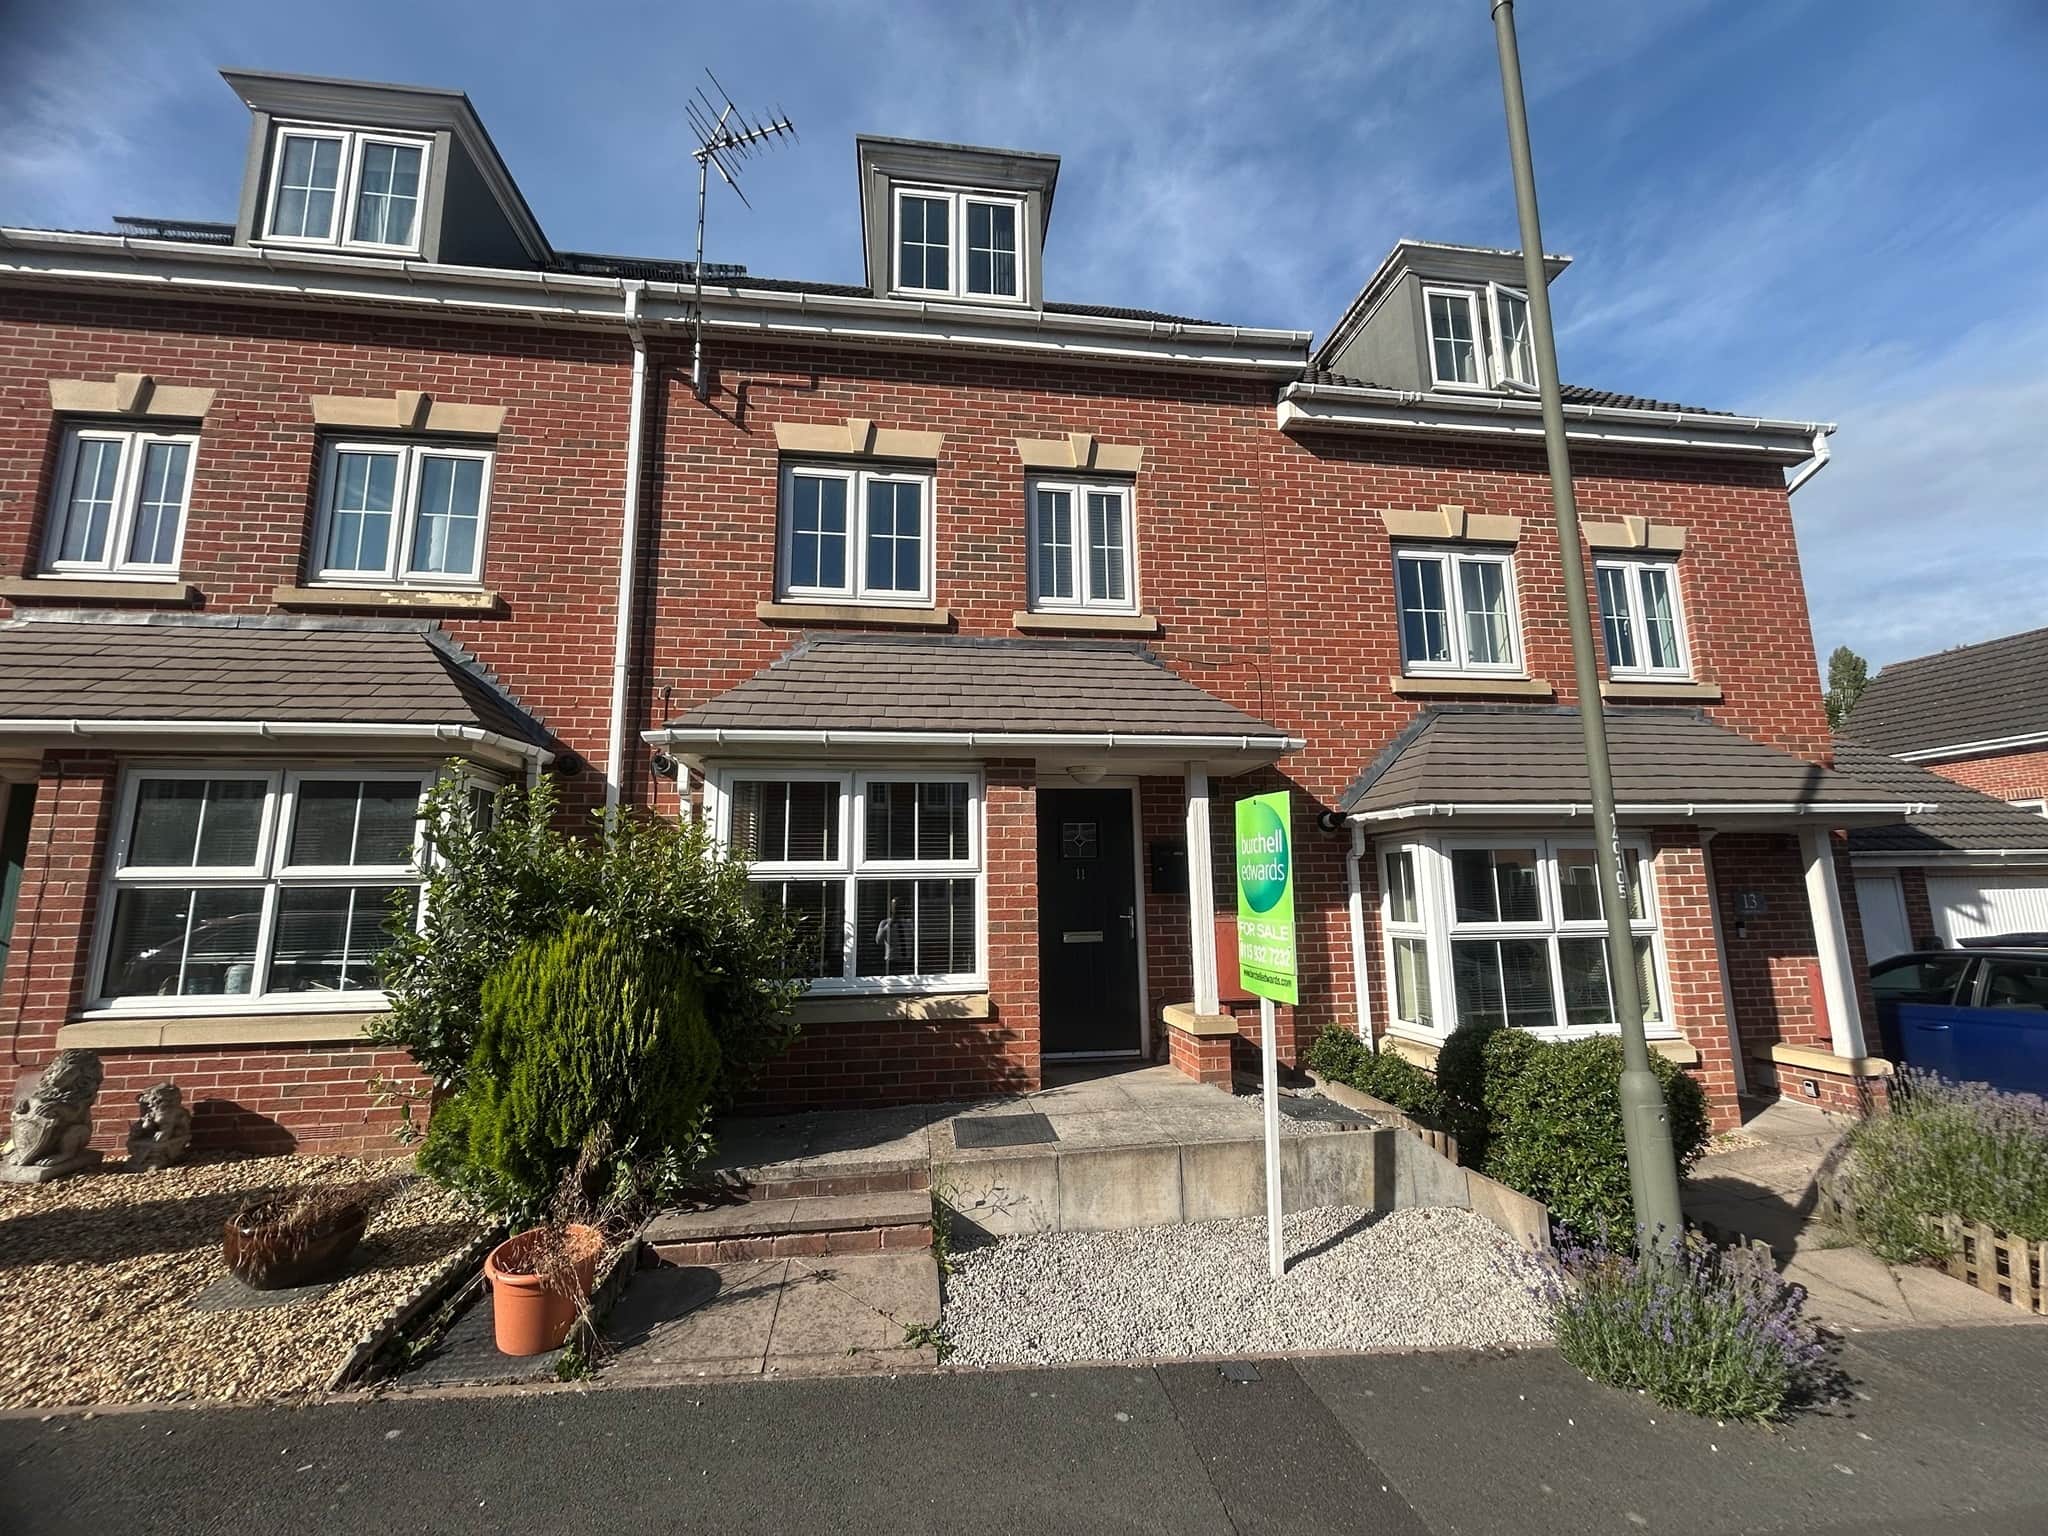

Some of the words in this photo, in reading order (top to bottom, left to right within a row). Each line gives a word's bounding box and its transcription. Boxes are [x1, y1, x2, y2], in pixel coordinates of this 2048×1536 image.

[1241, 829, 1283, 855] burchell
[1241, 857, 1285, 881] edwards
[1743, 894, 1757, 909] 13
[1239, 921, 1256, 937] FOR
[1257, 923, 1289, 940] SALE
